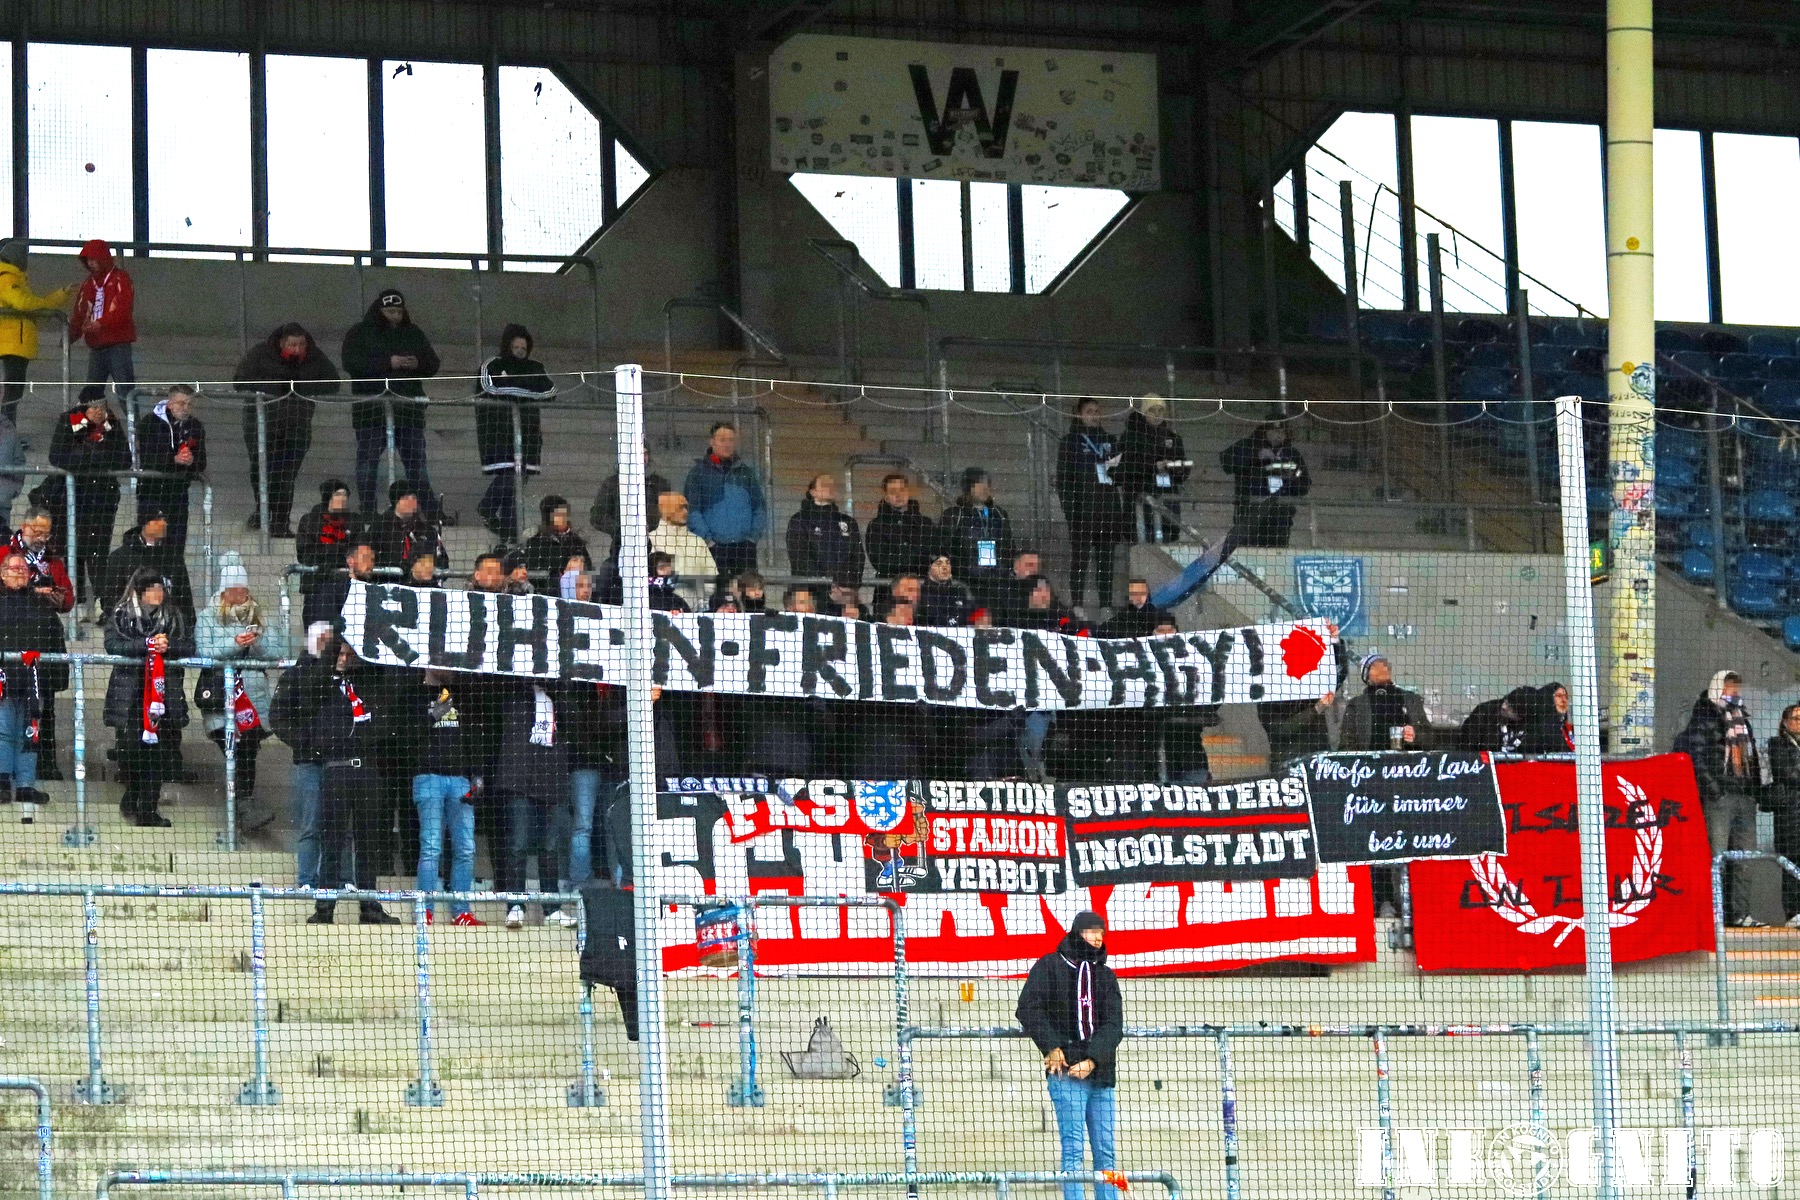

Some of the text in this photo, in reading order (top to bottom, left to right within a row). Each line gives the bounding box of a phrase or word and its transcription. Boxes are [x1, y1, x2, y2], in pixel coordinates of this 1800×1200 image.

[906, 64, 1020, 159] W
[362, 584, 1266, 708] RUHE N FRIEDEN AGY!
[1382, 756, 1431, 780] und
[1436, 753, 1486, 781] Lars
[929, 780, 1057, 816] SEKTION
[1067, 777, 1306, 818] SUPPORTERS
[1343, 793, 1469, 825] für immer
[932, 817, 1060, 857] STADION
[1074, 829, 1311, 874] INGOLSTADT
[1368, 829, 1458, 853] bei uns
[934, 857, 1061, 894] VERBOT
[1458, 871, 1684, 910] ON TUR
